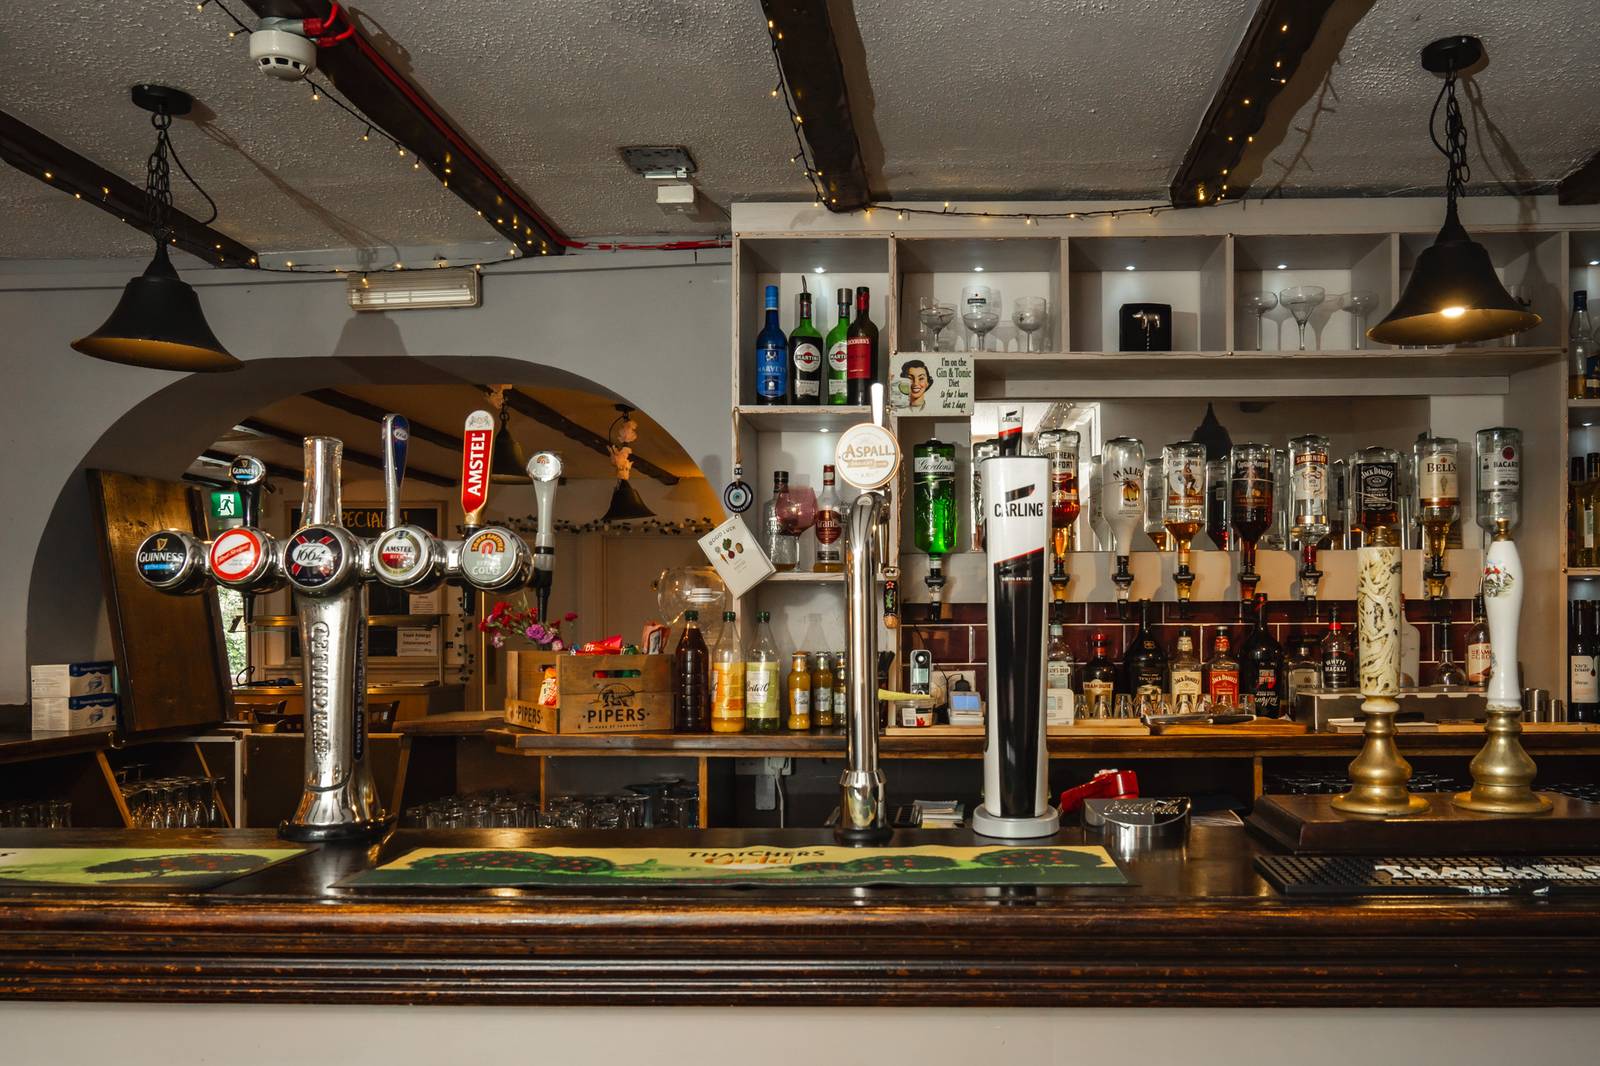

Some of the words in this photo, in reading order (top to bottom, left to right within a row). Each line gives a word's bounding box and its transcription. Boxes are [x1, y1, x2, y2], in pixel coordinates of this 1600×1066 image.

[941, 357, 951, 366] I'm
[958, 357, 967, 366] the
[936, 368, 948, 378] Gin
[948, 369, 955, 378] &
[955, 368, 972, 378] Tonic
[948, 379, 960, 388] Diet
[942, 401, 951, 409] lost
[956, 401, 966, 411] days
[843, 443, 892, 460] ASPALL
[467, 432, 486, 496] AMSTEL
[1426, 462, 1457, 473] BELL'S
[232, 466, 259, 475] GUINNESS
[1361, 468, 1374, 479] JACK
[1373, 466, 1394, 479] DANIEL'S
[994, 502, 1043, 517] CARLING
[296, 547, 326, 561] 1664
[385, 545, 412, 553] AMSTEL
[139, 551, 184, 563] GUINNESS
[1325, 658, 1346, 666] WHYTE
[517, 705, 542, 724] PIPERS
[587, 708, 646, 723] PIPERS
[1374, 864, 1600, 879] THATCHERS
